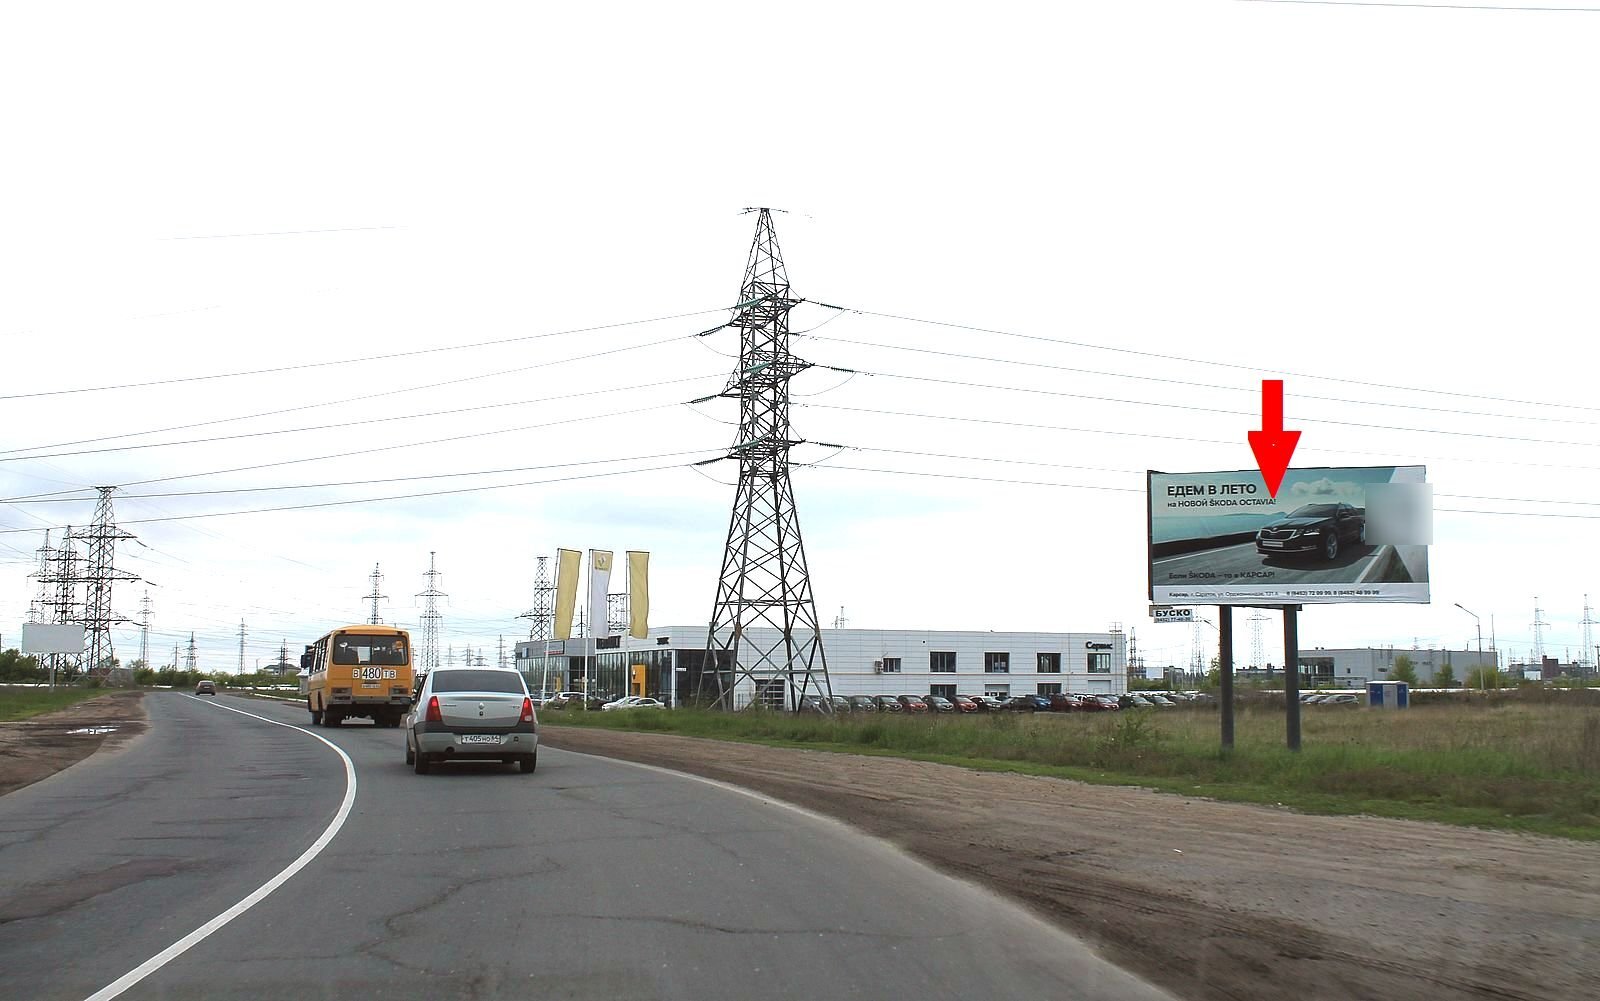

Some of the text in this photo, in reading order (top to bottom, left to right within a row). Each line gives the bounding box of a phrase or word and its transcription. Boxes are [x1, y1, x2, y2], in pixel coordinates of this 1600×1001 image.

[1167, 484, 1257, 497] ЕДЕМ В ЛЕТО
[1178, 499, 1208, 507] НОВОЙ
[1209, 498, 1238, 507] ŠKODA
[1155, 609, 1191, 617] БУСКО
[362, 667, 381, 679] 480
